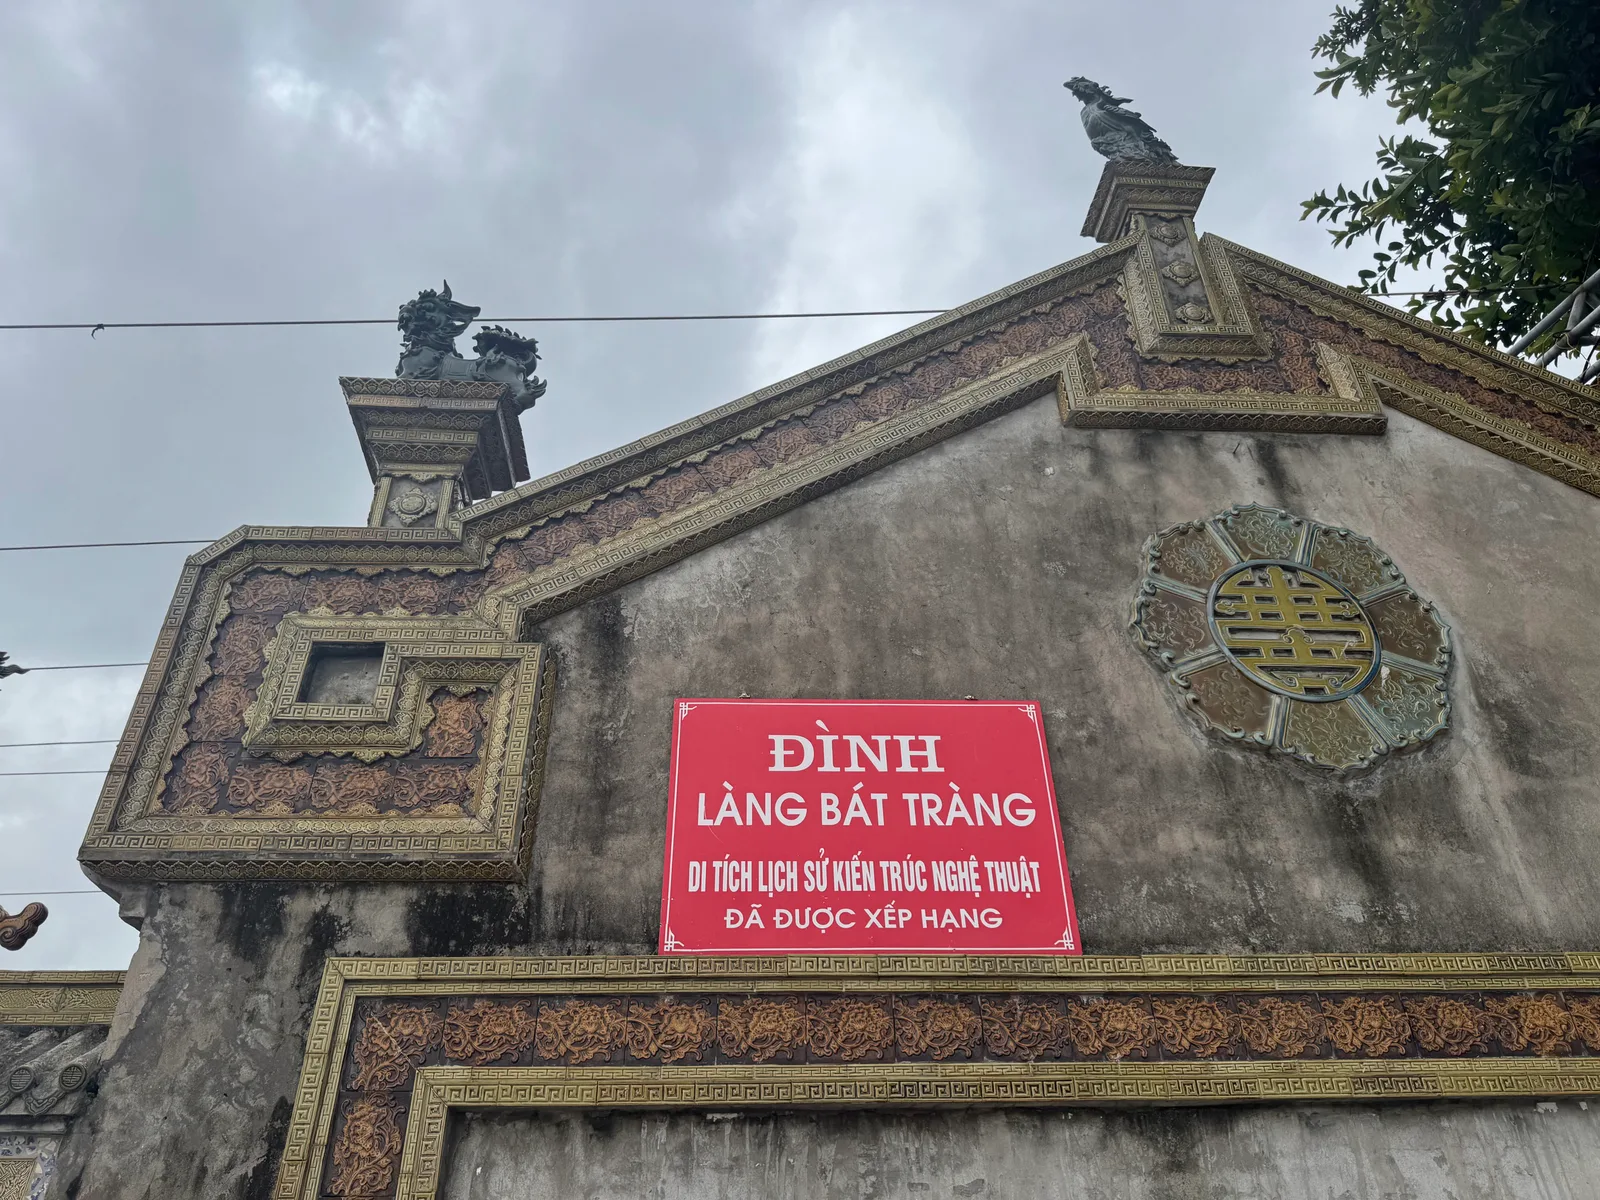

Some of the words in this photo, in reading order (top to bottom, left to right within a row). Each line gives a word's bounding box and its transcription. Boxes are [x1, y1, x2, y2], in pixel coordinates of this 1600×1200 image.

[768, 719, 945, 773] ĐÌNH
[697, 780, 808, 827] LÀNG
[820, 781, 888, 827] BÁT
[902, 781, 1036, 827] TRÀNG
[688, 860, 707, 893] DI
[712, 853, 753, 893] TÍCH
[758, 860, 798, 898] LỊCH
[803, 847, 830, 893] SỬ
[832, 850, 876, 893] KIẾN
[879, 854, 928, 893] TRÚC
[931, 854, 982, 898] NGHỆ
[983, 855, 1041, 899] THUẬT
[723, 903, 765, 929] ĐÃ
[772, 907, 856, 934] ĐƯỢC
[863, 899, 913, 930] XẾP
[920, 907, 1003, 933] HẠNG
